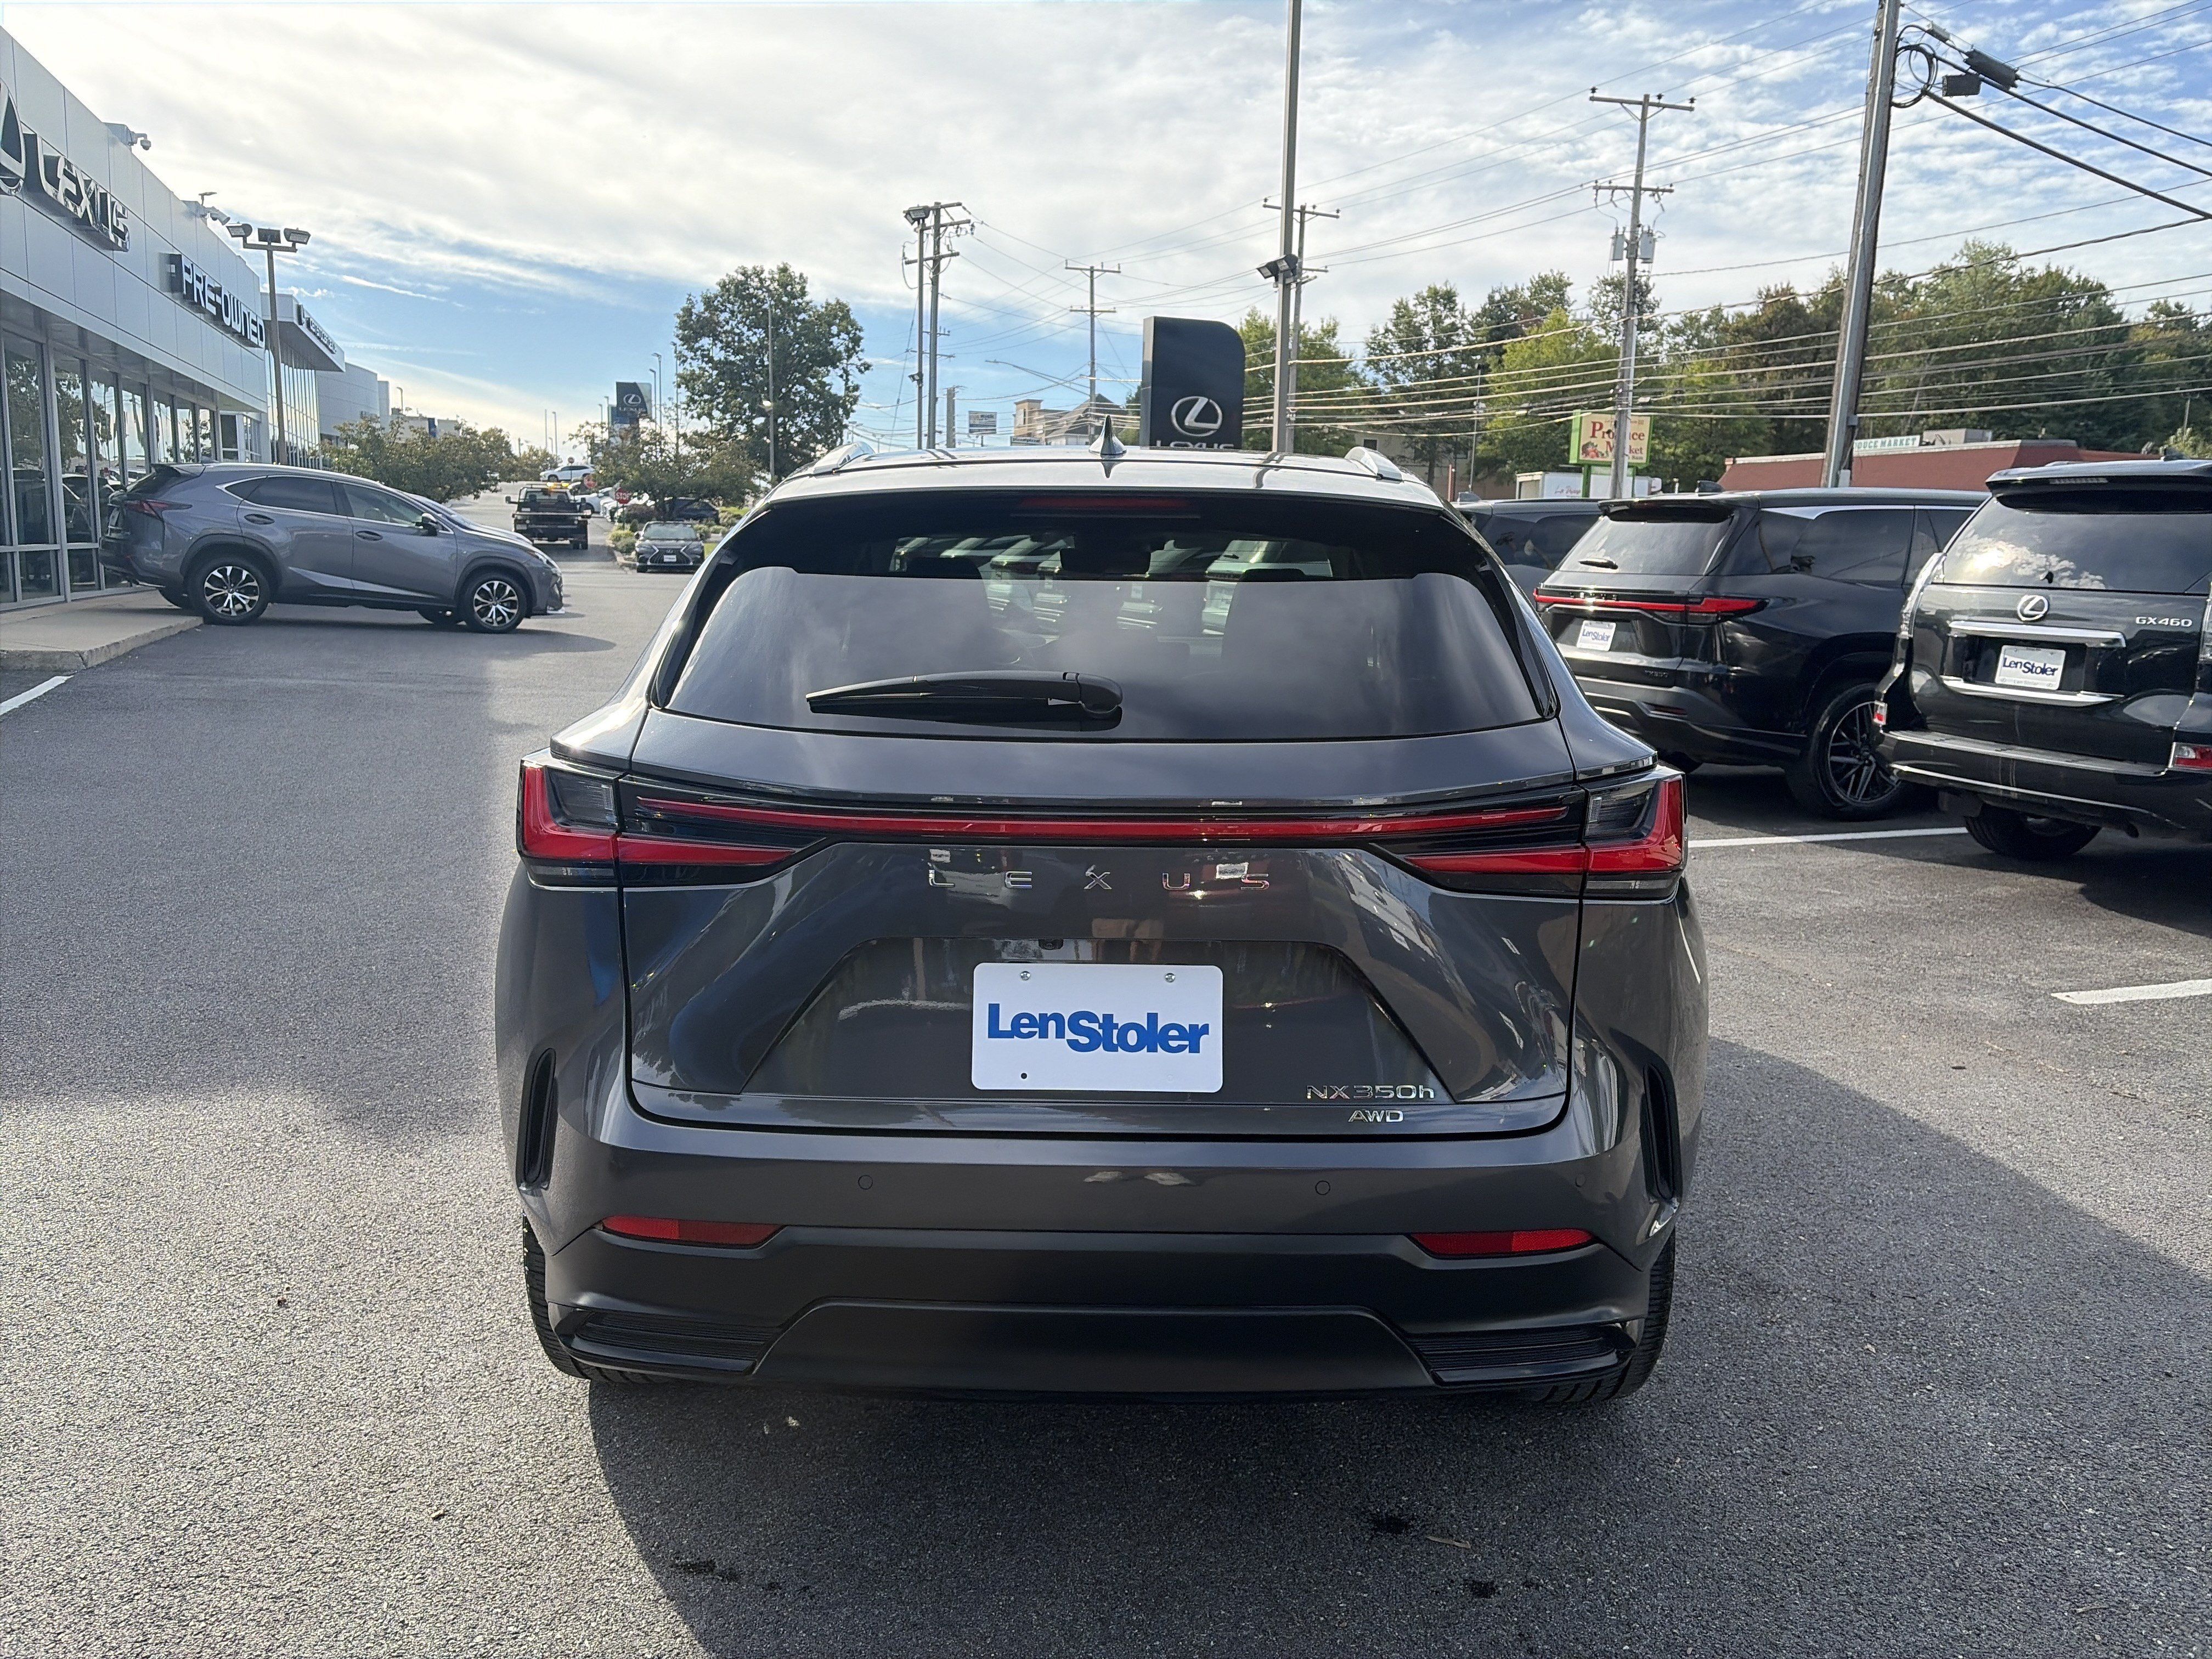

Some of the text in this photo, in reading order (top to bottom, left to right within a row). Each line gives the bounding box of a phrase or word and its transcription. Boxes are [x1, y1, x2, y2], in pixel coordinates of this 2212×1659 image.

[34, 133, 129, 251] LEXUS
[182, 255, 265, 349] PRE-OWNED
[1590, 420, 1645, 440] Proce
[1880, 438, 1917, 447] MARKET
[2136, 616, 2193, 627] GX460
[928, 868, 1269, 891] LEXUS
[1348, 1110, 1403, 1122] AWD
